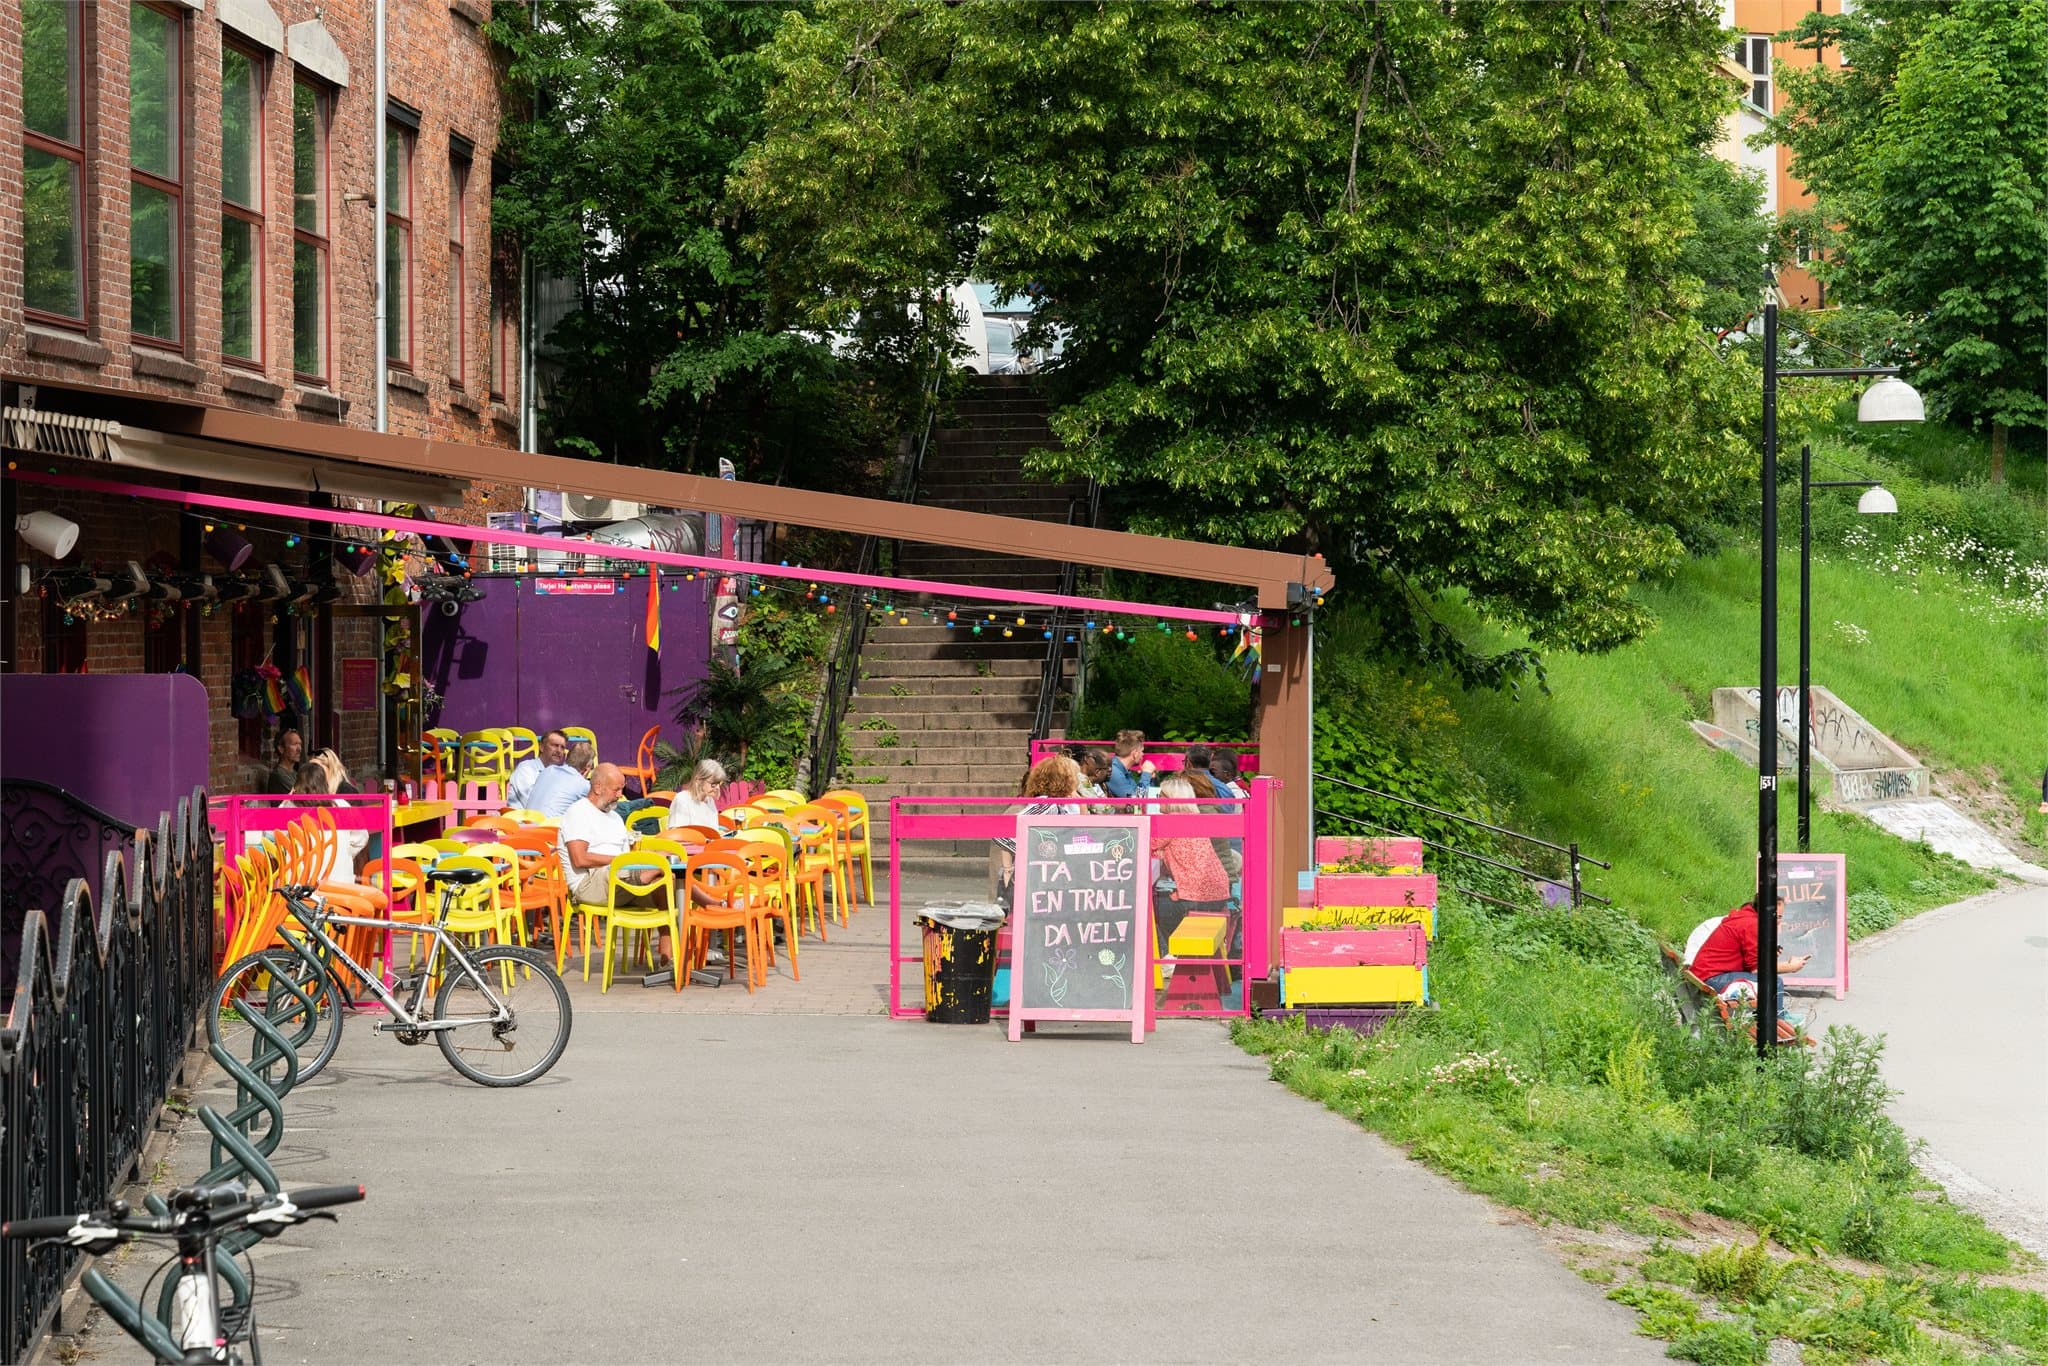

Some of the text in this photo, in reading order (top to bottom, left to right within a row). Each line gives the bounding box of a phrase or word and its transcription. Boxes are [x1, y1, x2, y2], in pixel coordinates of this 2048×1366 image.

[593, 582, 611, 591] plass
[1029, 859, 1133, 882] TA DEG
[1032, 889, 1132, 913] EN TRALL
[1044, 921, 1129, 947] DA VEL!
